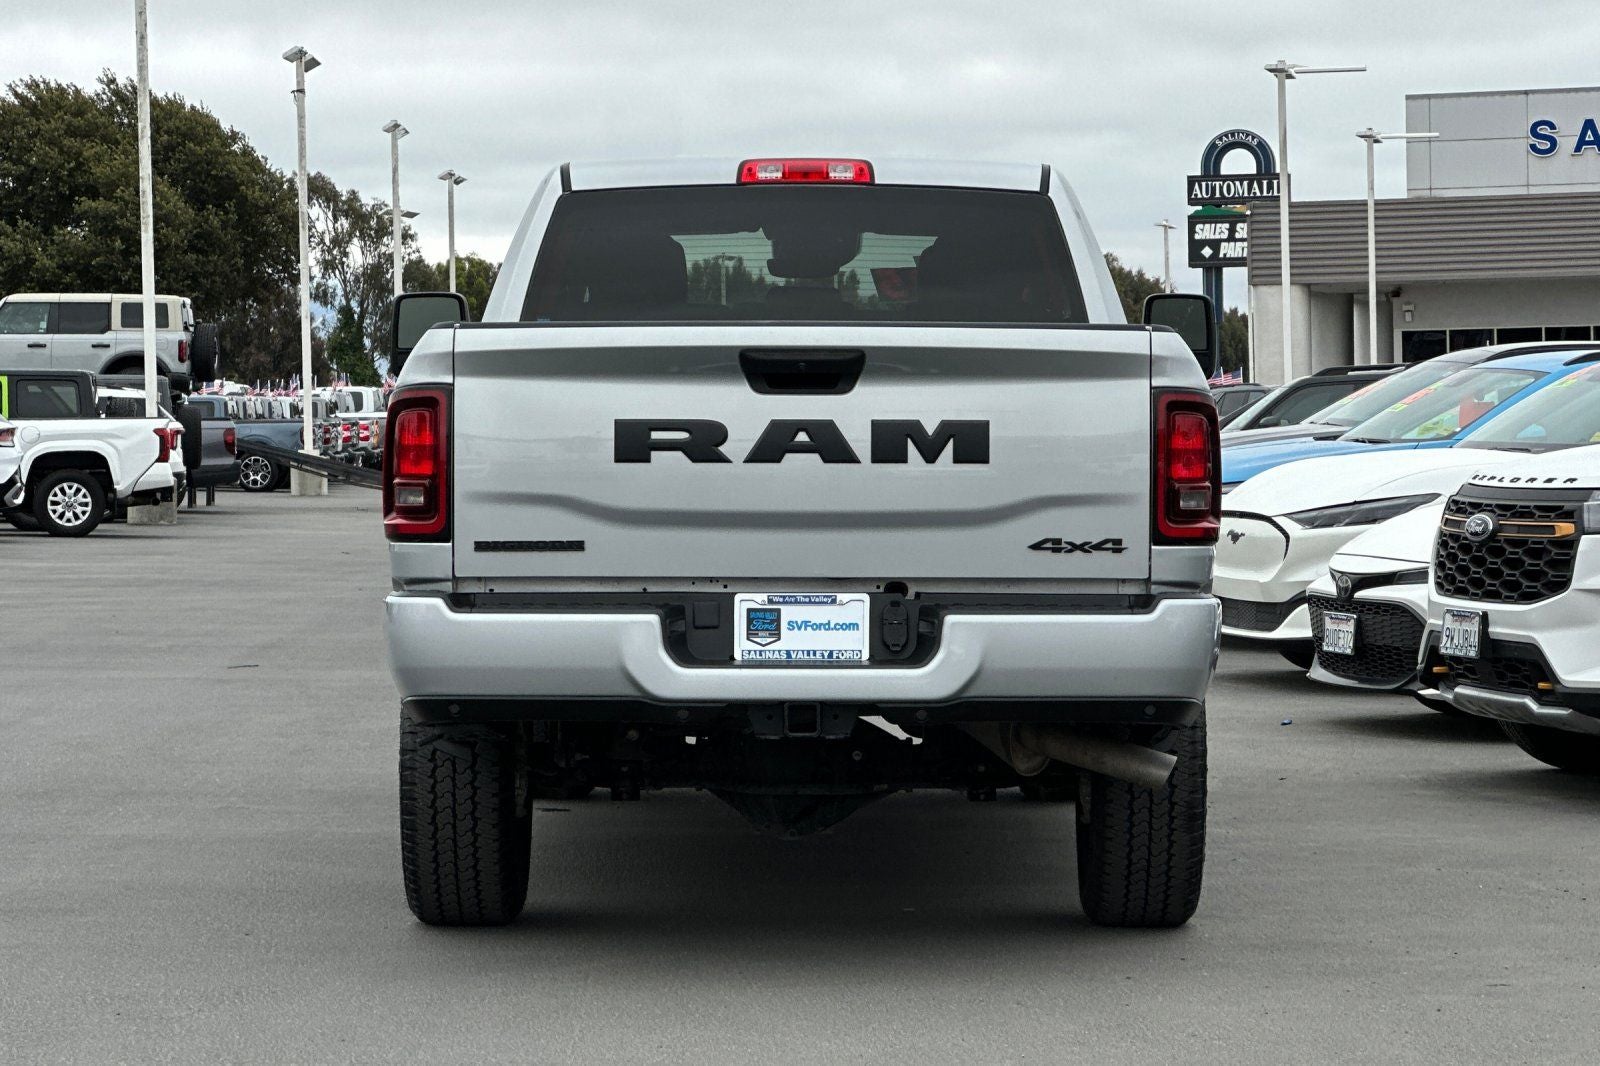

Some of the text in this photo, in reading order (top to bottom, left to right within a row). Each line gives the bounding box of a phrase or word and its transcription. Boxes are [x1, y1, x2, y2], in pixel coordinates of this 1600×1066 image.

[1215, 132, 1259, 147] SALINAS
[1528, 118, 1600, 157] SA
[1191, 180, 1281, 198] AUTOMALL
[1194, 223, 1230, 240] SALES
[614, 419, 991, 464] RAM
[1471, 474, 1579, 484] EXPLORER
[1027, 537, 1129, 554] 4x4
[785, 595, 796, 603] Are
[797, 595, 810, 603] The
[750, 619, 777, 630] Ford
[787, 620, 859, 631] SVFord.com
[742, 650, 861, 659] SALINAS VALLEY FORD
